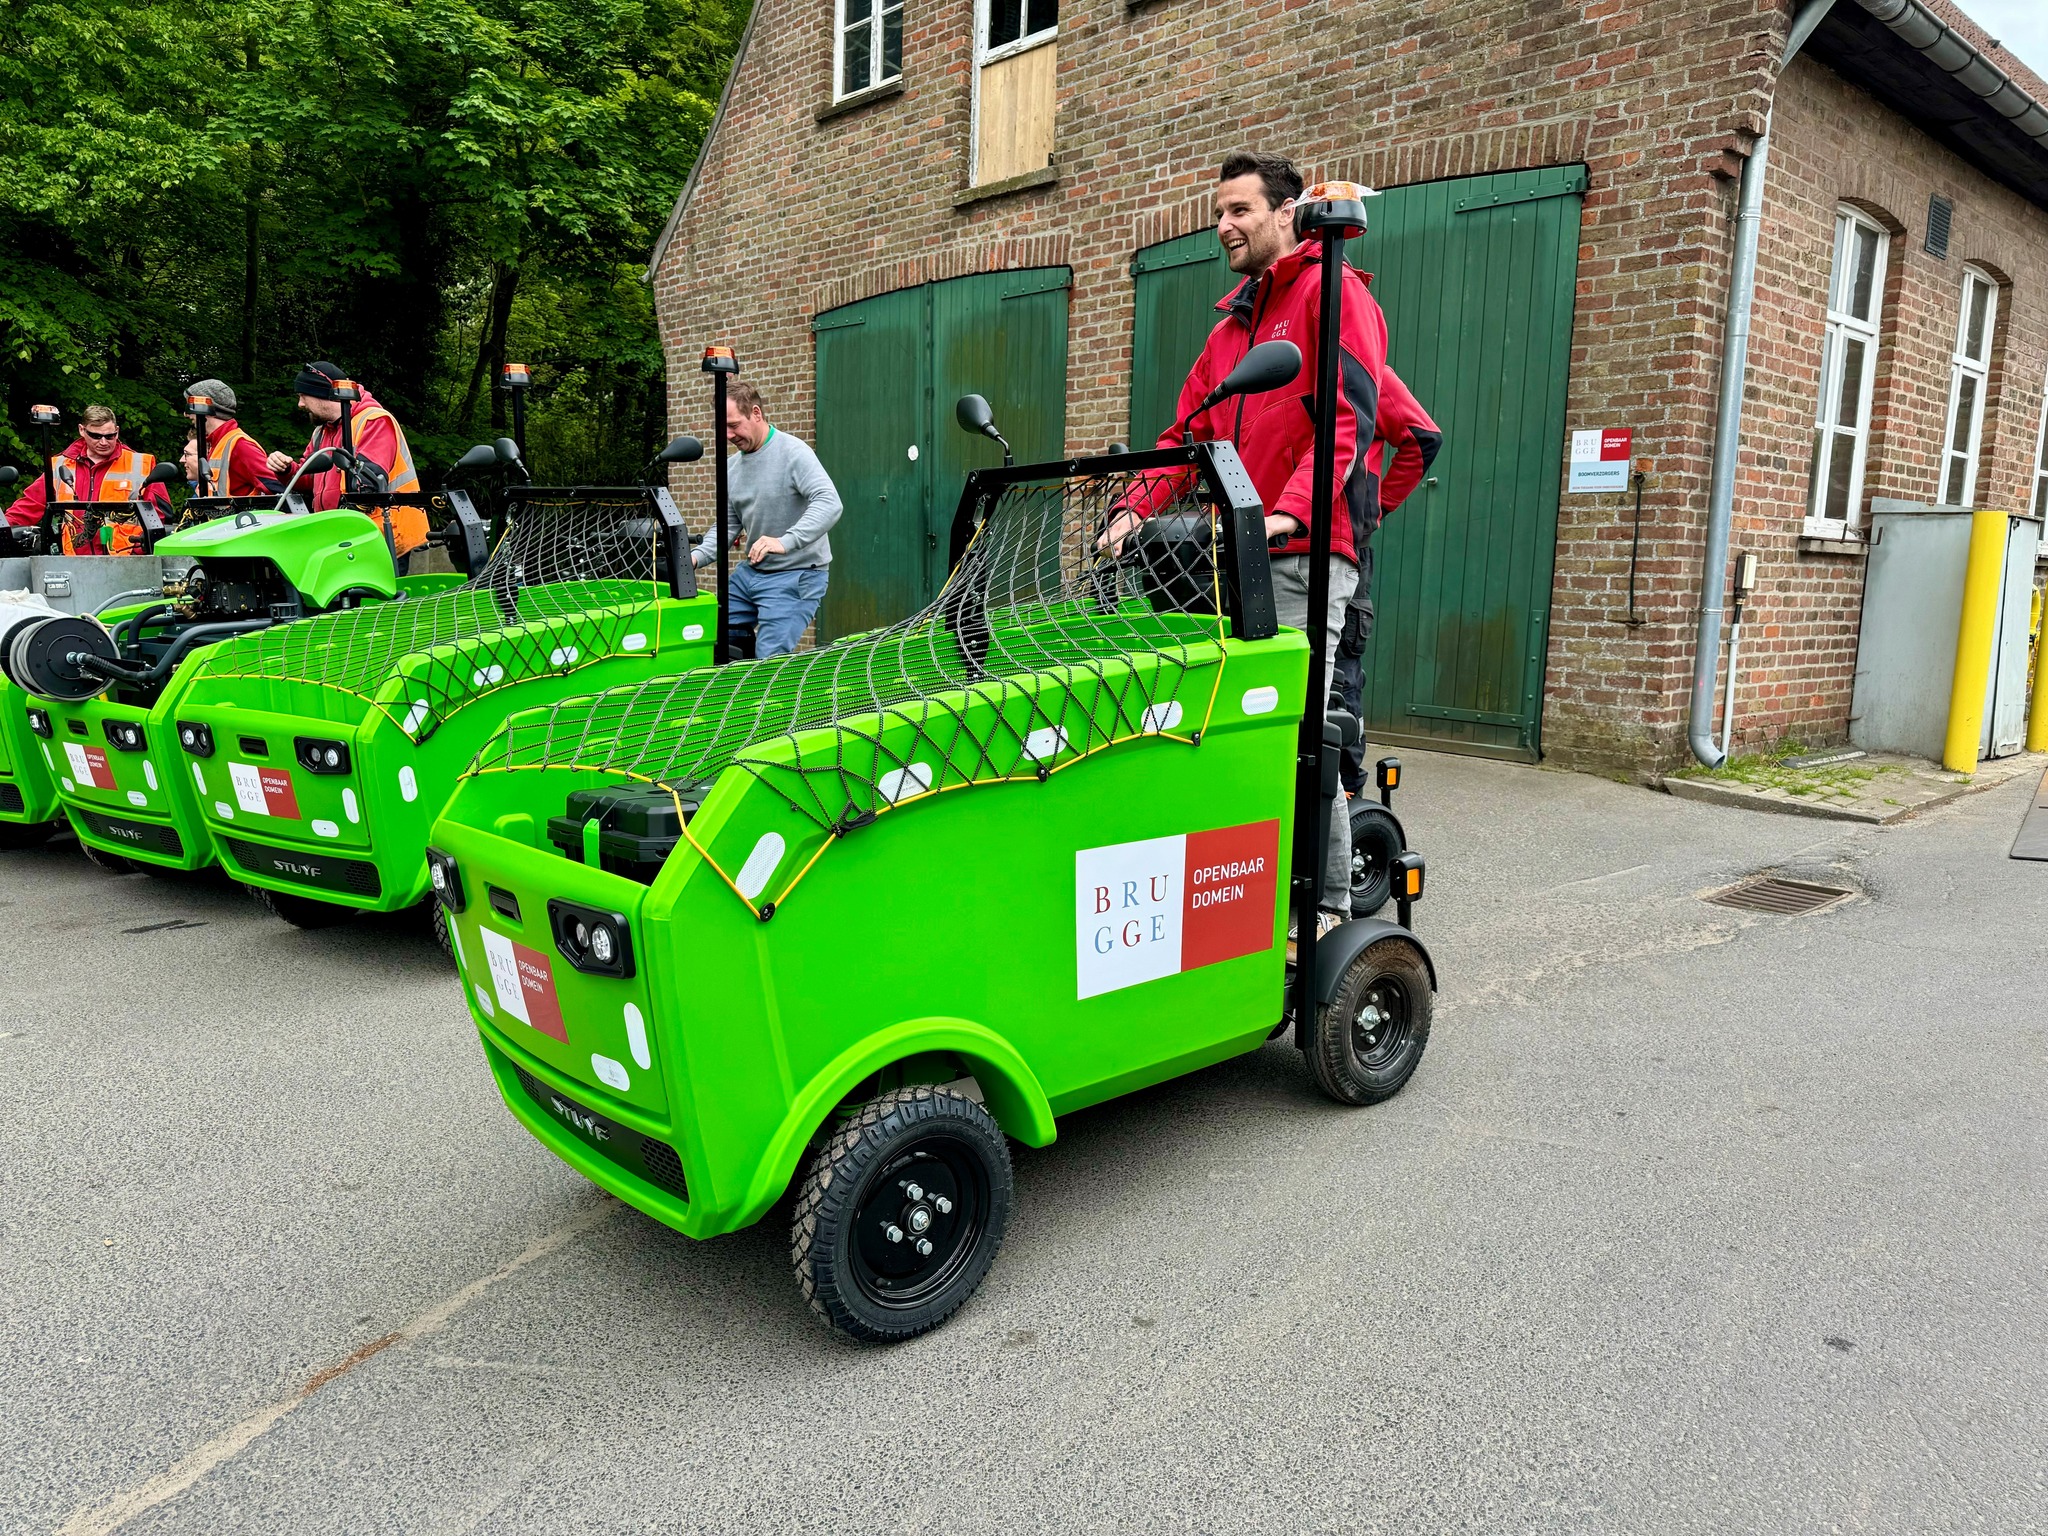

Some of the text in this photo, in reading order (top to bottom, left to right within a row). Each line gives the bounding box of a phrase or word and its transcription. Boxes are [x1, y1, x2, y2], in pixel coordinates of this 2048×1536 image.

[1271, 329, 1287, 338] GGE
[1574, 447, 1596, 455] GGE
[1576, 438, 1597, 446] BRU
[235, 775, 258, 789] BRU
[262, 777, 288, 787] OPENBAAR
[264, 786, 283, 794] DOMEIN
[239, 789, 262, 803] GGE
[108, 825, 143, 841] STUYF
[273, 859, 322, 877] STUYF
[1193, 856, 1265, 886] OPENBAAR
[1094, 873, 1169, 915] BRU
[1191, 883, 1245, 910] DOMEIN
[1094, 913, 1166, 955] GGE
[489, 950, 514, 976] BRU
[518, 959, 549, 982] OPENBAAR
[495, 973, 520, 1001] GGE
[521, 974, 544, 994] DOMEIN
[550, 1094, 612, 1142] STUYF
